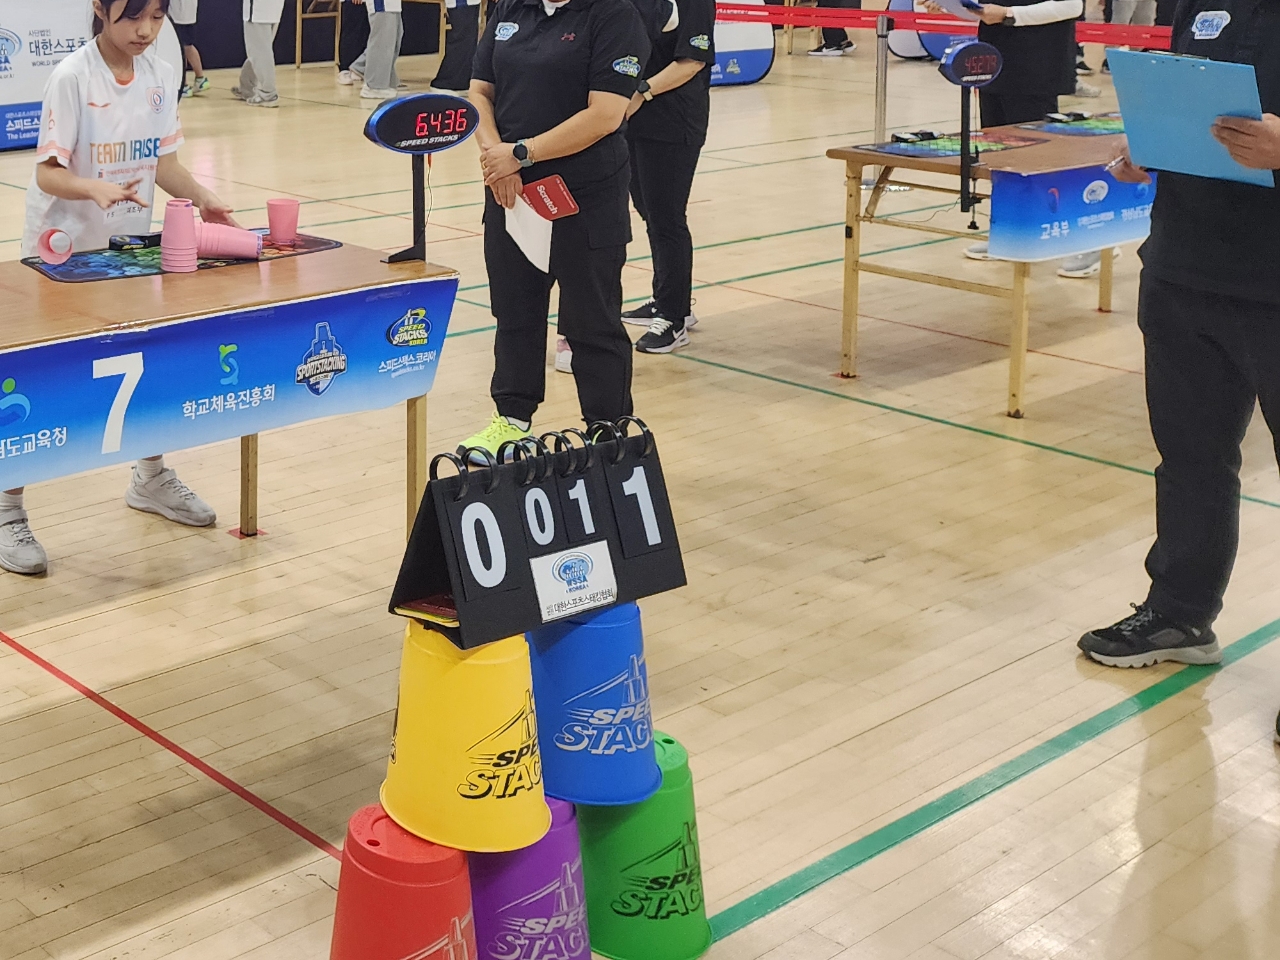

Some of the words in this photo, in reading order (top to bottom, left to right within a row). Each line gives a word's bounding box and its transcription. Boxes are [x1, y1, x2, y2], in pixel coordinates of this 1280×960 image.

[415, 108, 468, 137] 6.436
[90, 141, 126, 164] TEAM
[400, 138, 428, 148] SPEED
[429, 134, 459, 145] STACKS
[536, 184, 558, 215] Scratch
[1040, 220, 1070, 239] 교육부
[392, 329, 428, 345] STACKS
[398, 323, 425, 334] SPEED
[416, 349, 437, 363] 코리아
[297, 355, 346, 381] SPORTSTACKING
[92, 352, 145, 454] 7
[182, 384, 276, 420] 학교체육진흥회
[461, 501, 507, 588] 0
[525, 487, 555, 546] 0
[568, 479, 596, 535] 1
[622, 465, 662, 547] 1
[565, 575, 588, 587] WSSA
